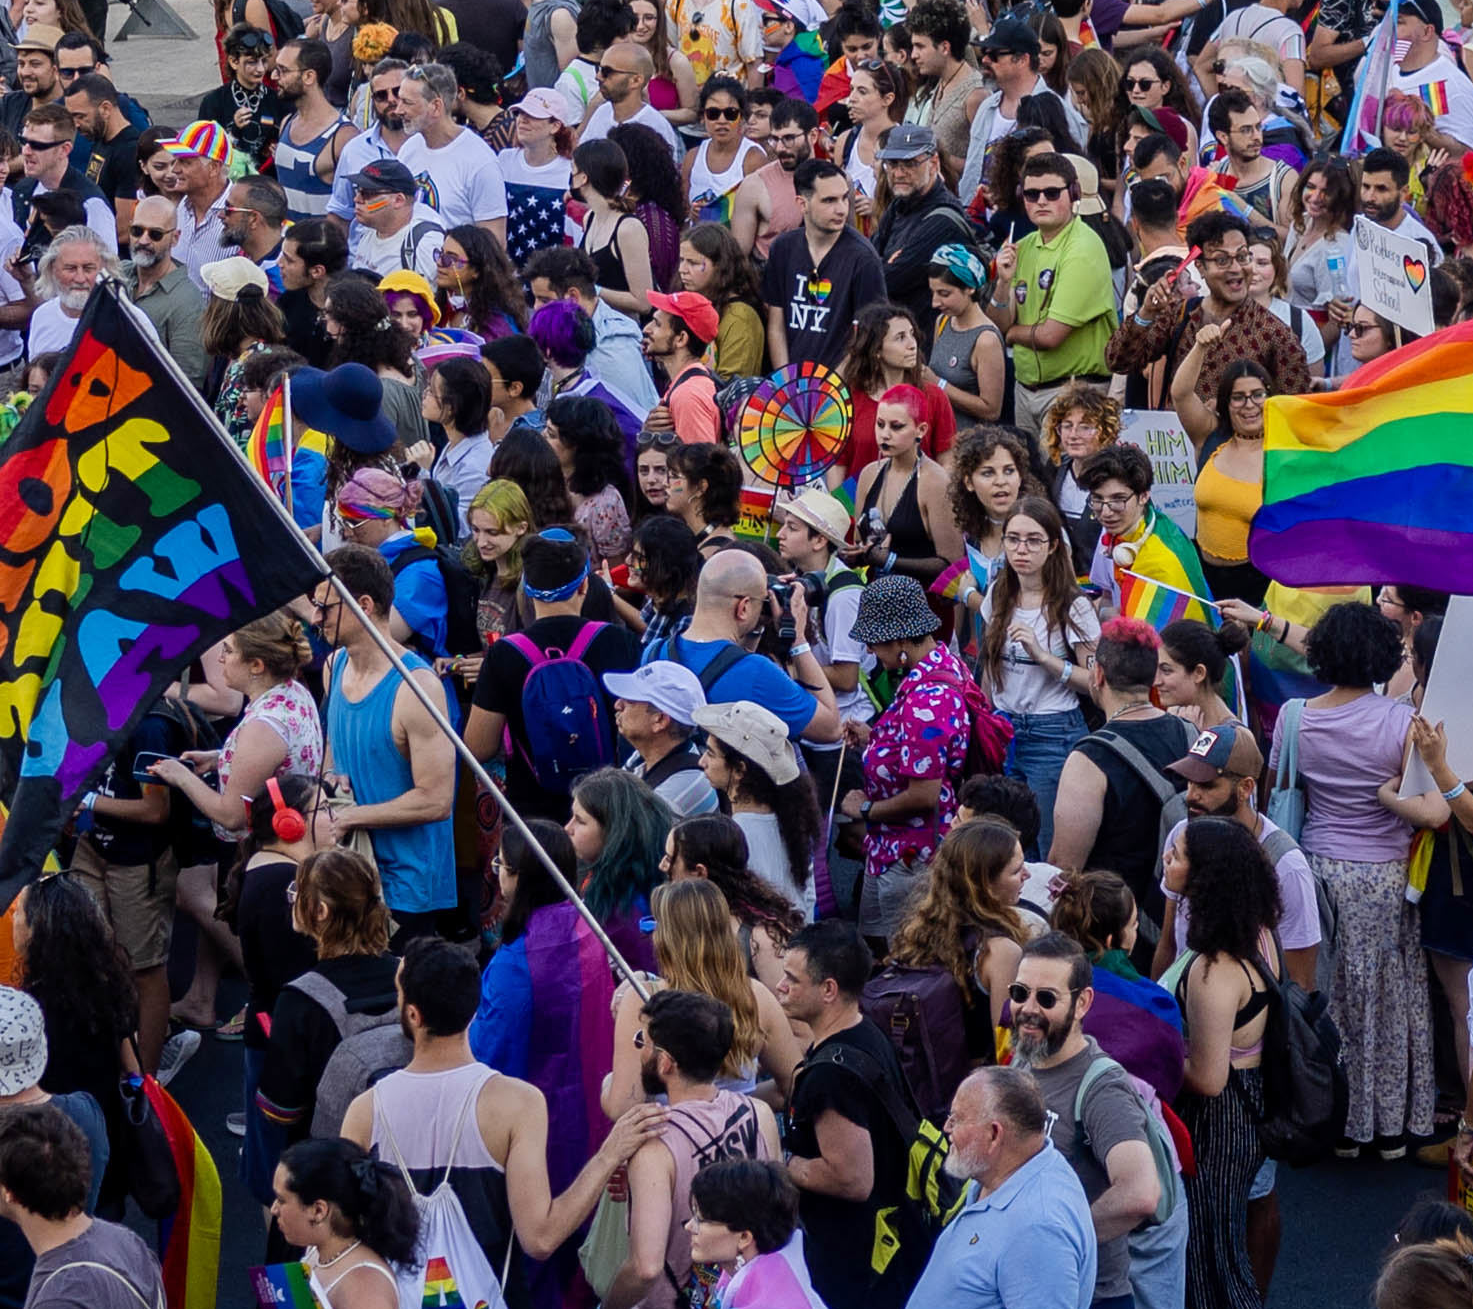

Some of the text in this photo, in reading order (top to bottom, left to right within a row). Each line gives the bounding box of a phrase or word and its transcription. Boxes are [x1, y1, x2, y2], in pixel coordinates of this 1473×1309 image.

[792, 273, 808, 302] I
[789, 302, 831, 333] NY
[1145, 429, 1188, 457] HIM
